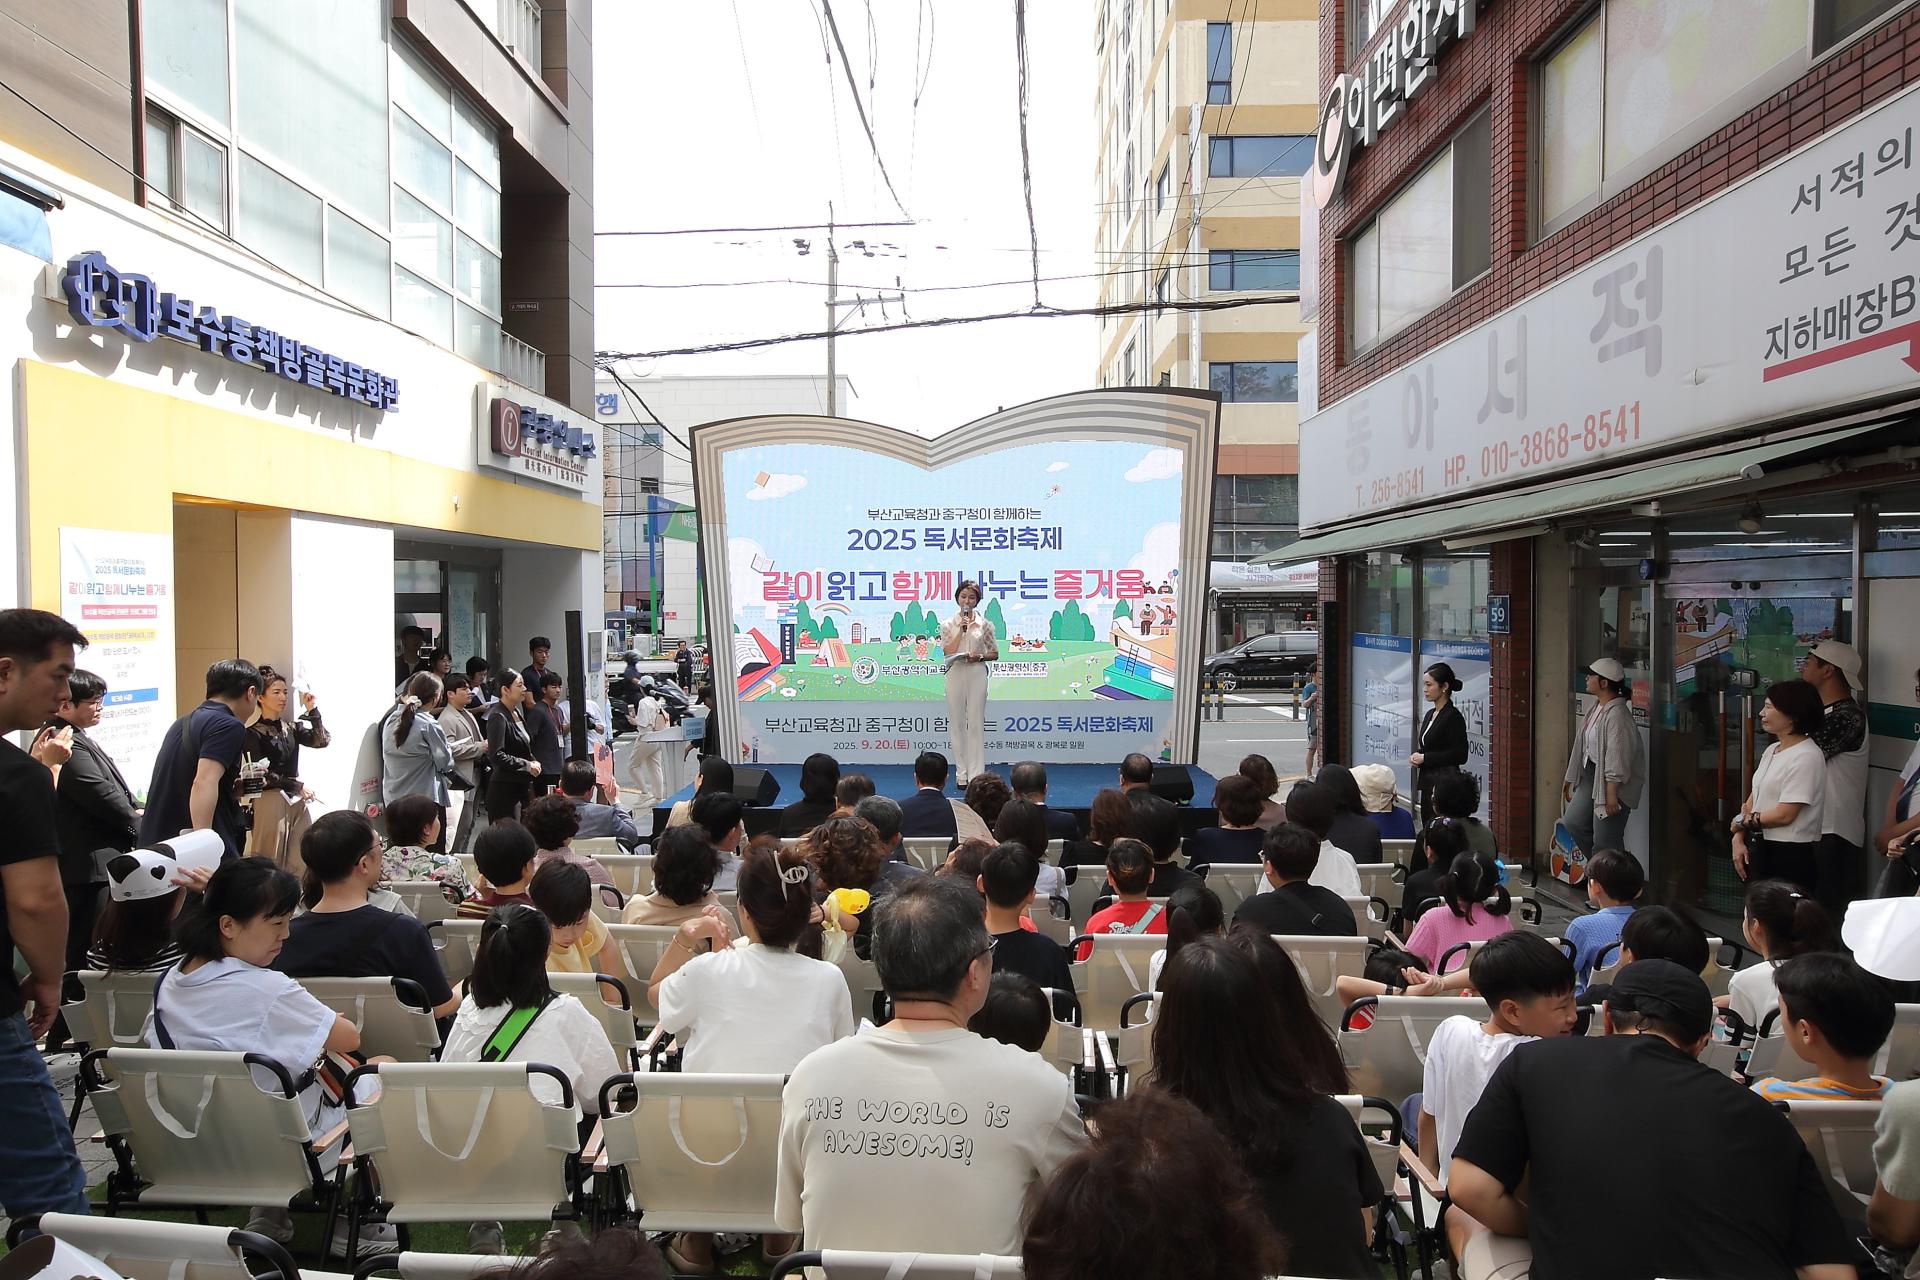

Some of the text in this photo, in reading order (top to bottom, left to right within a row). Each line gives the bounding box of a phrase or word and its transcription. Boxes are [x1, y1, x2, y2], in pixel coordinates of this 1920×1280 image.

[1790, 127, 1913, 215] 서적의
[1779, 225, 1857, 285] 모든
[1764, 274, 1920, 360] 지하매장B
[161, 292, 400, 413] 보수동책방골목문화관
[523, 443, 586, 473] Tourist Information Center
[1371, 466, 1426, 504] 256-8541
[1444, 454, 1471, 487] HP.
[1481, 400, 1641, 478] 010-3868-8541
[867, 507, 1042, 521] 부산교육청과 중구청이 함께하는
[846, 526, 1063, 551] 2025 독서문화축제
[86, 582, 105, 595] 읽고
[120, 583, 145, 596] 나누는
[762, 570, 821, 602] 같이
[827, 571, 887, 601] 읽고
[892, 571, 952, 601] 함께
[1053, 569, 1145, 600] 즐거움
[1491, 607, 1505, 622] 59
[765, 717, 862, 734] 부산교육청과
[865, 717, 930, 733] 중구청이
[1003, 716, 1053, 732] 2025
[1056, 716, 1154, 733] 독서문화축제
[833, 742, 859, 750] 2025.
[861, 740, 873, 750] 9.
[875, 739, 910, 751] 20.(토)
[913, 741, 952, 750] 10:00~18
[1004, 740, 1035, 750] 책방골목
[1036, 741, 1044, 749] &
[1469, 740, 1485, 757] OKS
[804, 1096, 843, 1122] THE
[857, 1098, 968, 1125] WORLD
[823, 1129, 974, 1166] AWESOME!
